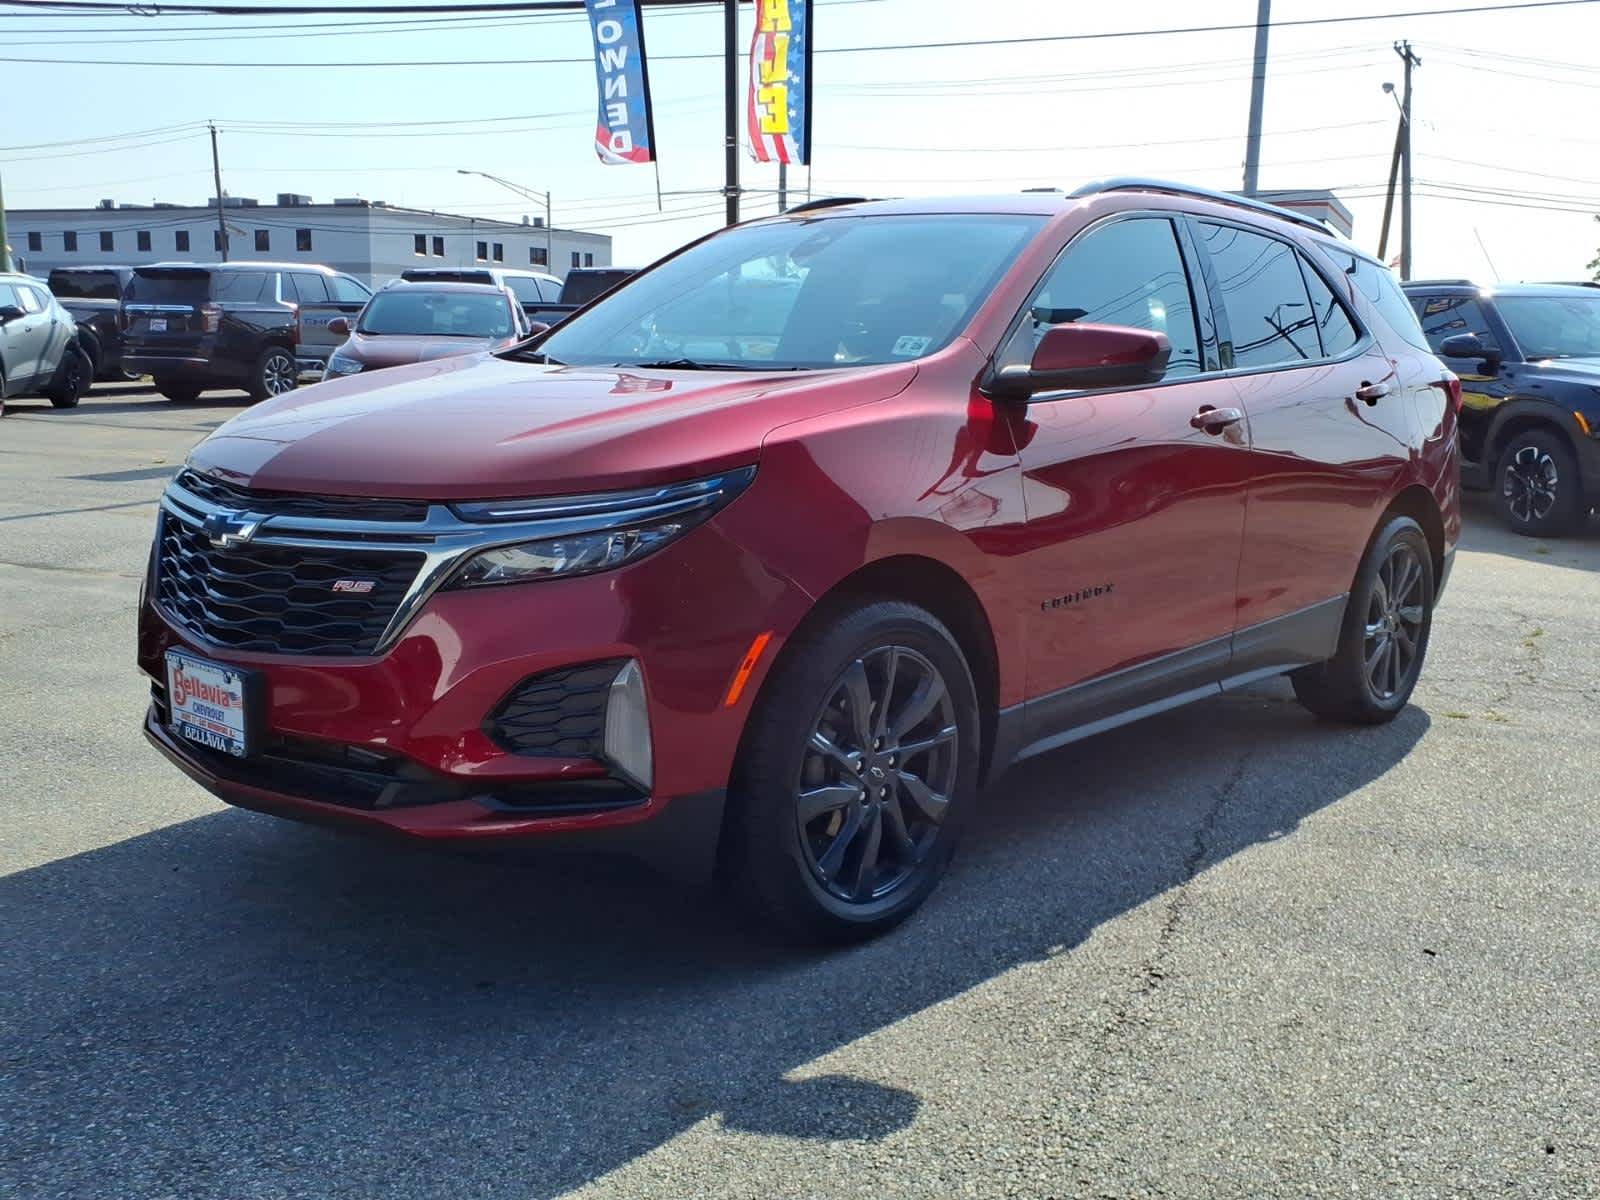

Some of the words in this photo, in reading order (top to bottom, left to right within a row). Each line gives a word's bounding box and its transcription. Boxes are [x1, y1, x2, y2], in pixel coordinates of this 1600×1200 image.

[332, 580, 375, 592] RS
[1041, 583, 1114, 611] EQUINOX
[174, 668, 230, 706] Bellavia
[193, 702, 224, 720] CHEVROLET
[185, 726, 226, 752] BELLAVIA
